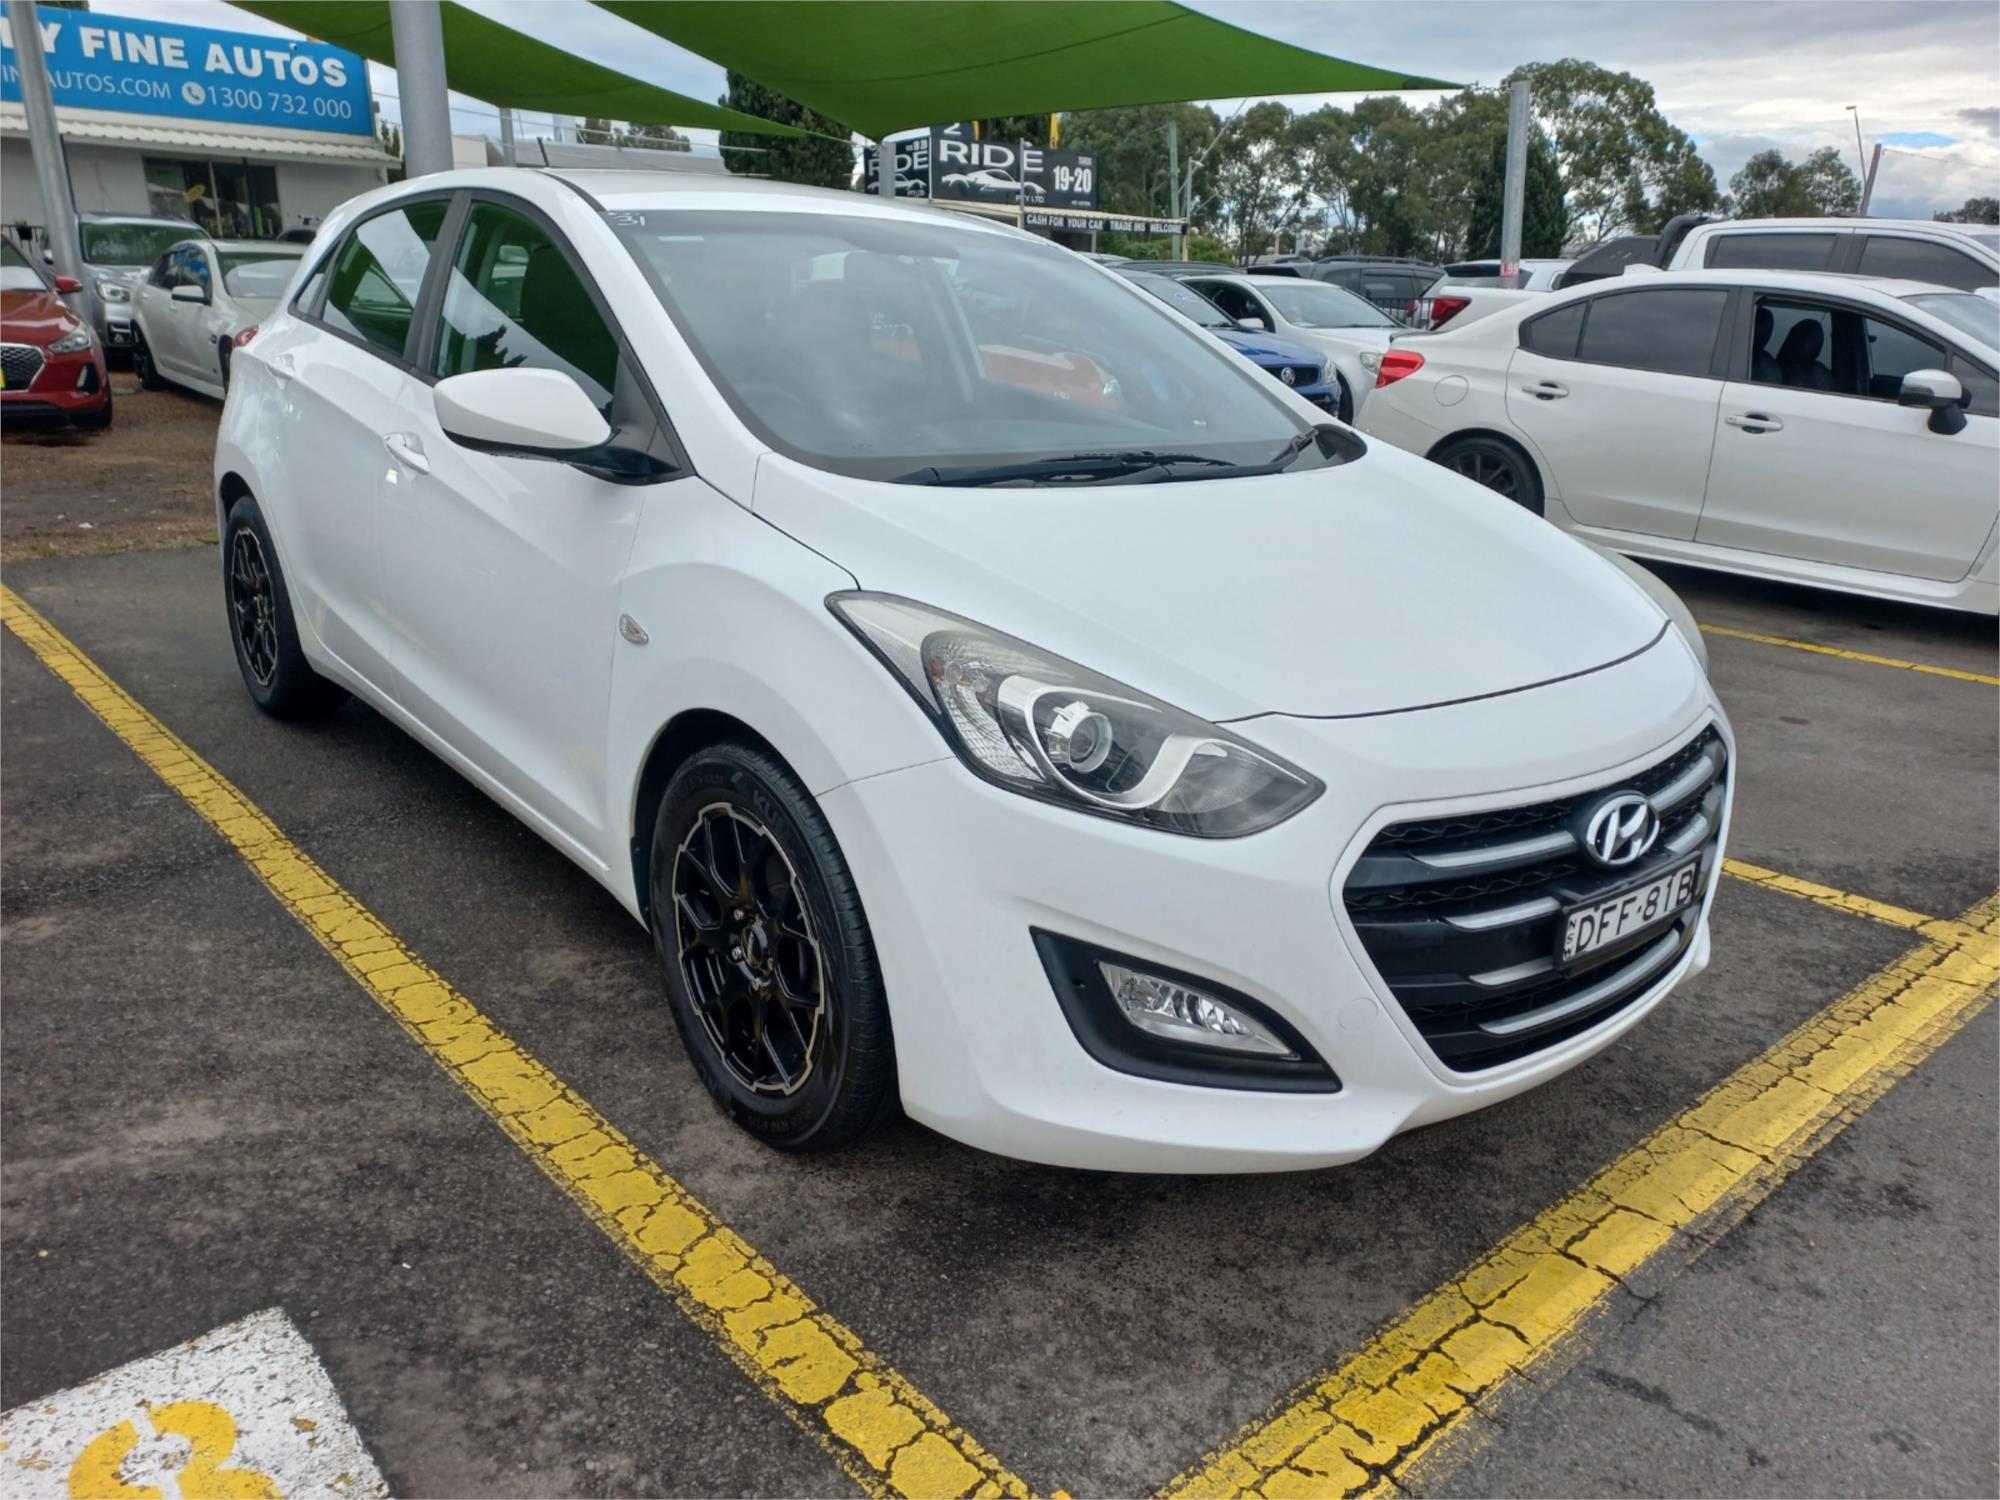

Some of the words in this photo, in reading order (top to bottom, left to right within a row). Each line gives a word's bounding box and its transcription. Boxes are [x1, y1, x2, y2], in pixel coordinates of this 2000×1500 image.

[79, 26, 189, 69] FINE
[205, 43, 347, 88] AUTOS
[207, 85, 263, 110] 1300
[267, 92, 308, 115] 732
[312, 97, 352, 119] 000
[868, 150, 929, 177] RDE
[939, 139, 1044, 172] RIDE
[1053, 165, 1092, 193] 19-20
[1026, 214, 1048, 225] CASH
[1049, 215, 1064, 227] FOR
[1067, 217, 1087, 229] YOUR
[1088, 218, 1104, 230] CAR
[1110, 220, 1133, 232] TRADE
[1150, 222, 1183, 235] WELCOME
